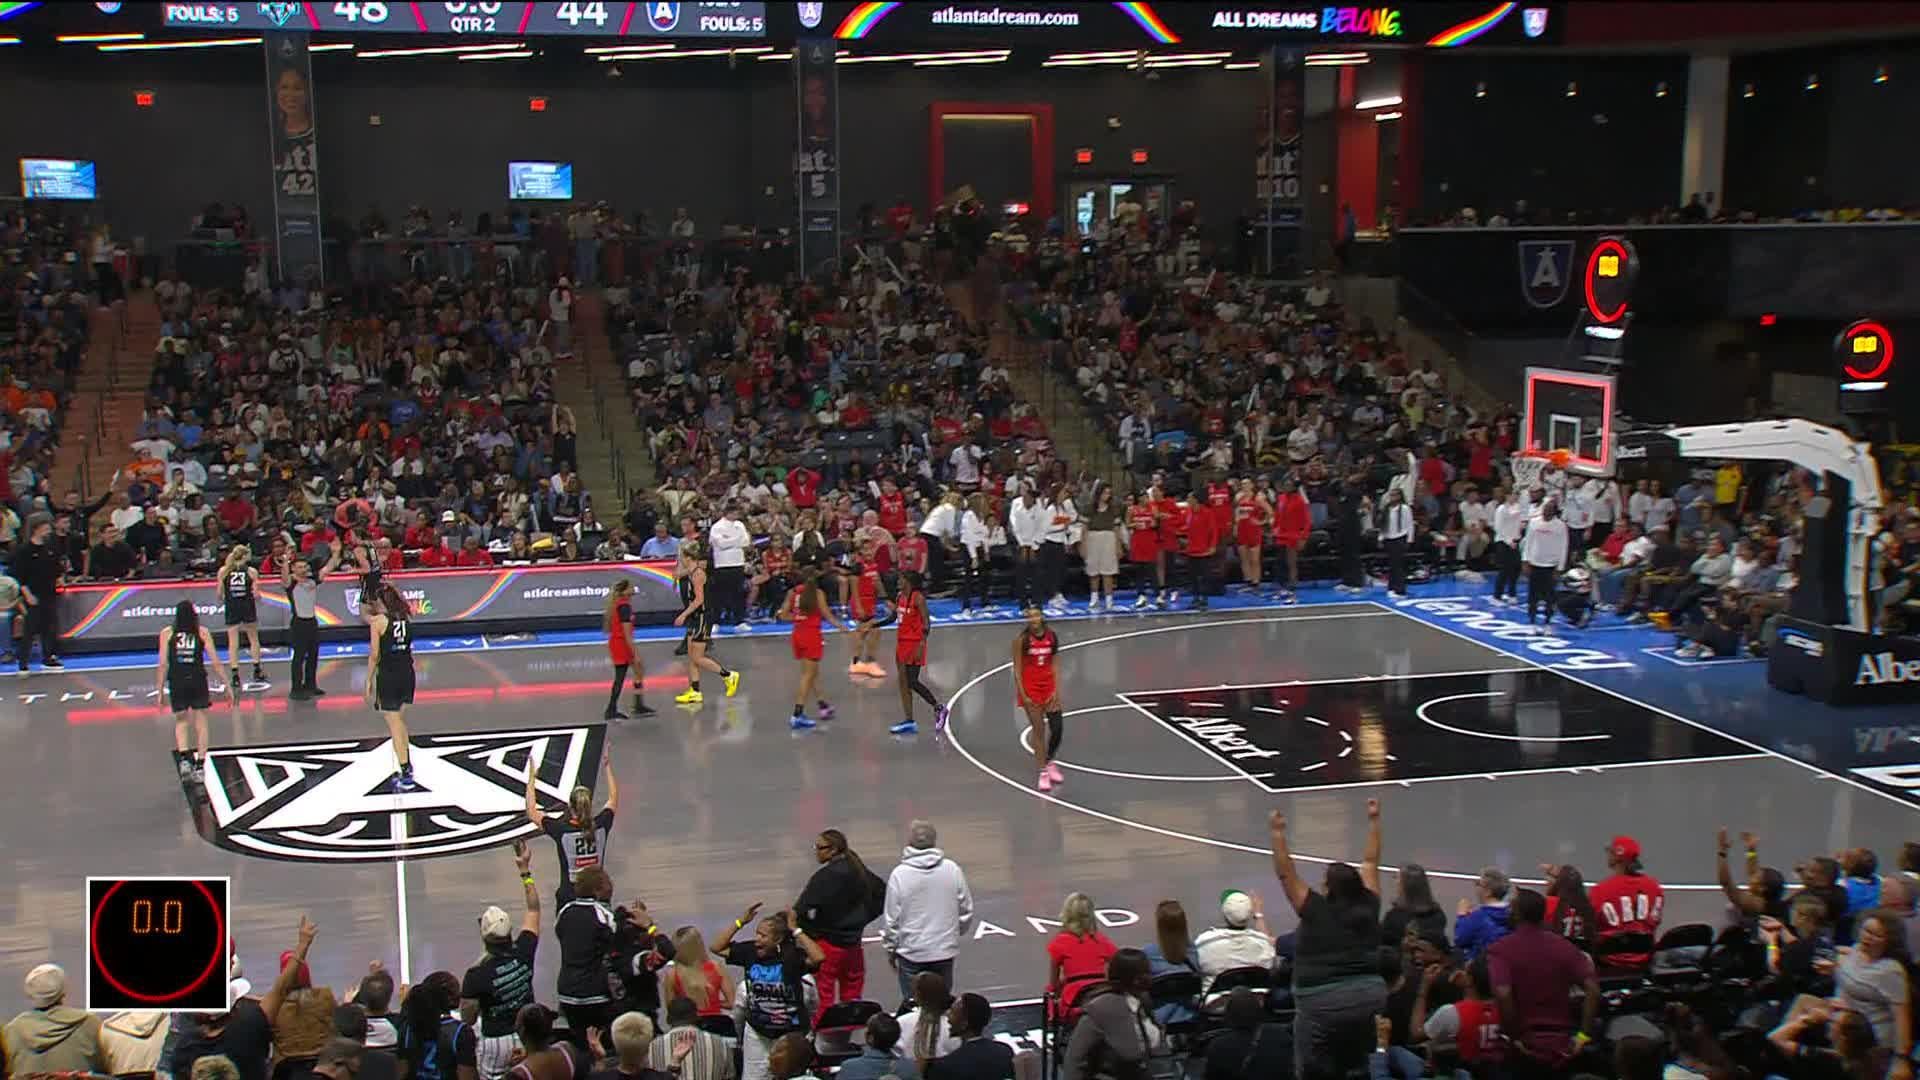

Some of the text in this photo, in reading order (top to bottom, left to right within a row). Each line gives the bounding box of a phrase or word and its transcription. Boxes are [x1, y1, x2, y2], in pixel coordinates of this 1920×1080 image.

[166, 5, 241, 23] FOULS: 5
[333, 0, 389, 23] 48
[556, 0, 609, 26] 44
[931, 6, 1079, 26] atlantadream.com
[1212, 11, 1245, 28] ALL
[1246, 12, 1318, 29] DREAMS
[451, 16, 497, 34] QTR 2
[700, 15, 763, 32] FOULS: 5
[229, 571, 246, 586] 23
[392, 620, 407, 638] 21
[1169, 715, 1281, 760] Albert
